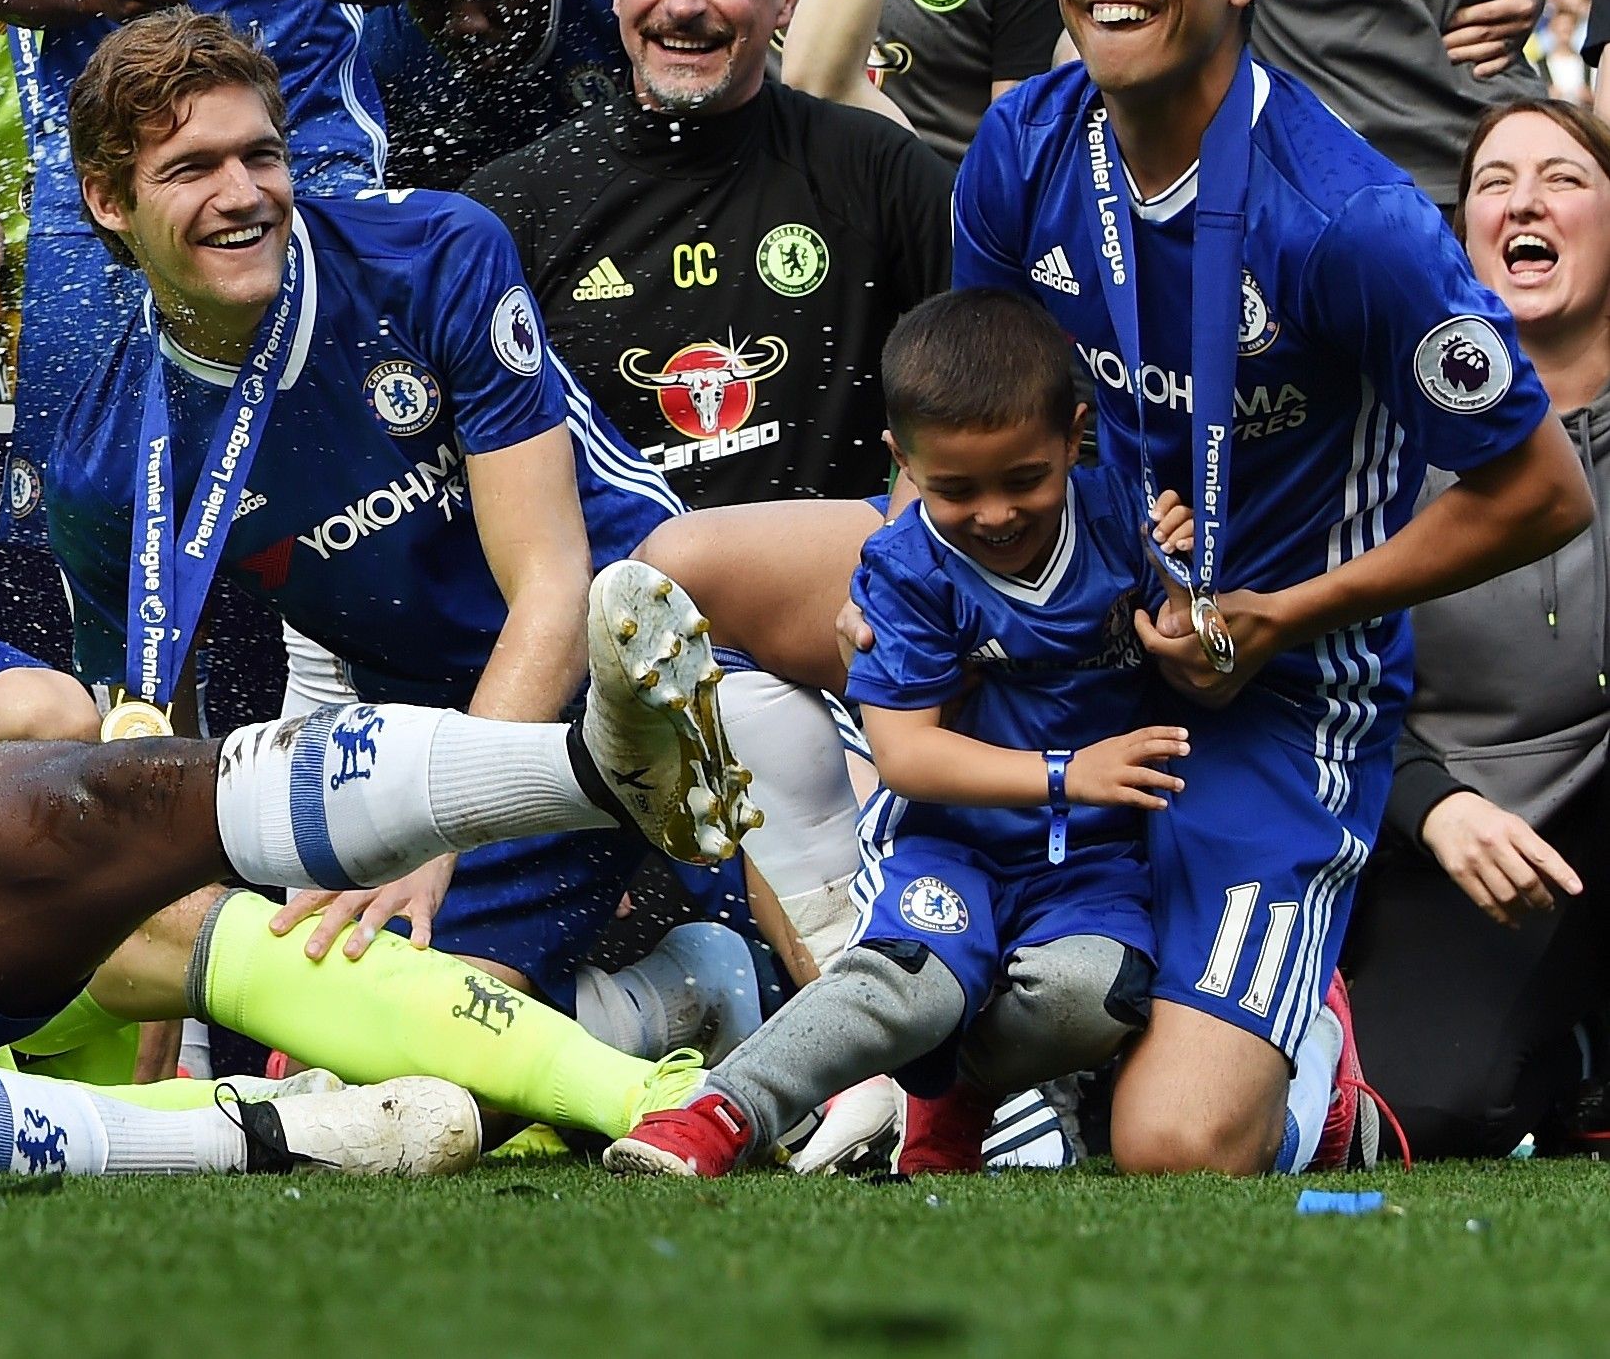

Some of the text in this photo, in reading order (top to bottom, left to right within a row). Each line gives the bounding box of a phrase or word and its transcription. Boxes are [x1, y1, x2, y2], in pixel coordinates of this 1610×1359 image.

[1085, 107, 1126, 287] Premier League
[766, 226, 813, 246] CHELSEA
[572, 282, 635, 302] adidas
[673, 242, 718, 289] CC
[1030, 265, 1080, 297] adidas
[251, 294, 292, 373] Premier
[367, 363, 414, 391] CHELSEA
[639, 419, 780, 473] Carabao
[1206, 424, 1226, 518] Premier
[185, 407, 256, 560] Premier League
[139, 436, 168, 703] Premier League Premier
[915, 878, 960, 903] CHELSEA
[1193, 880, 1299, 1019] 11
